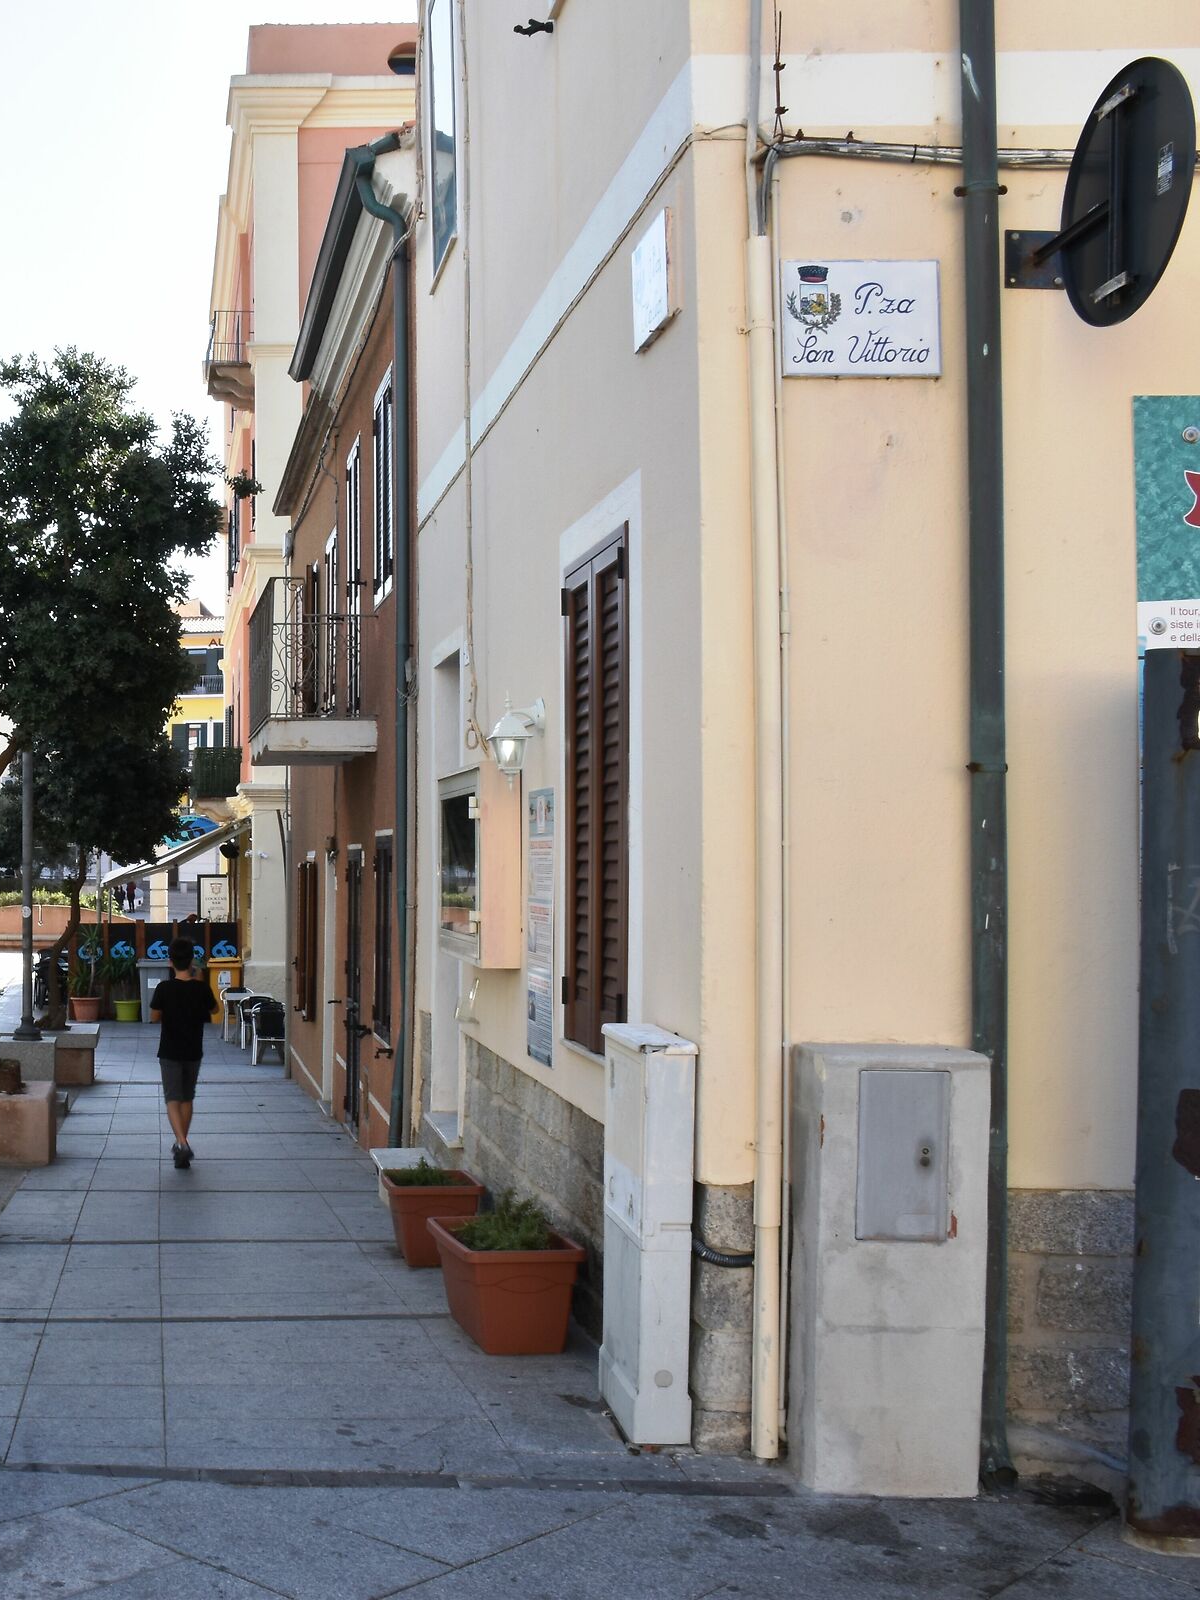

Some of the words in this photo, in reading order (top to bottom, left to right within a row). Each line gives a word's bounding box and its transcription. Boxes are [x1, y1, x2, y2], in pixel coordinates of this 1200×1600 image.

[854, 281, 916, 315] P.za
[792, 335, 835, 363] San
[847, 329, 931, 364] Vittorio
[1170, 621, 1193, 629] siste
